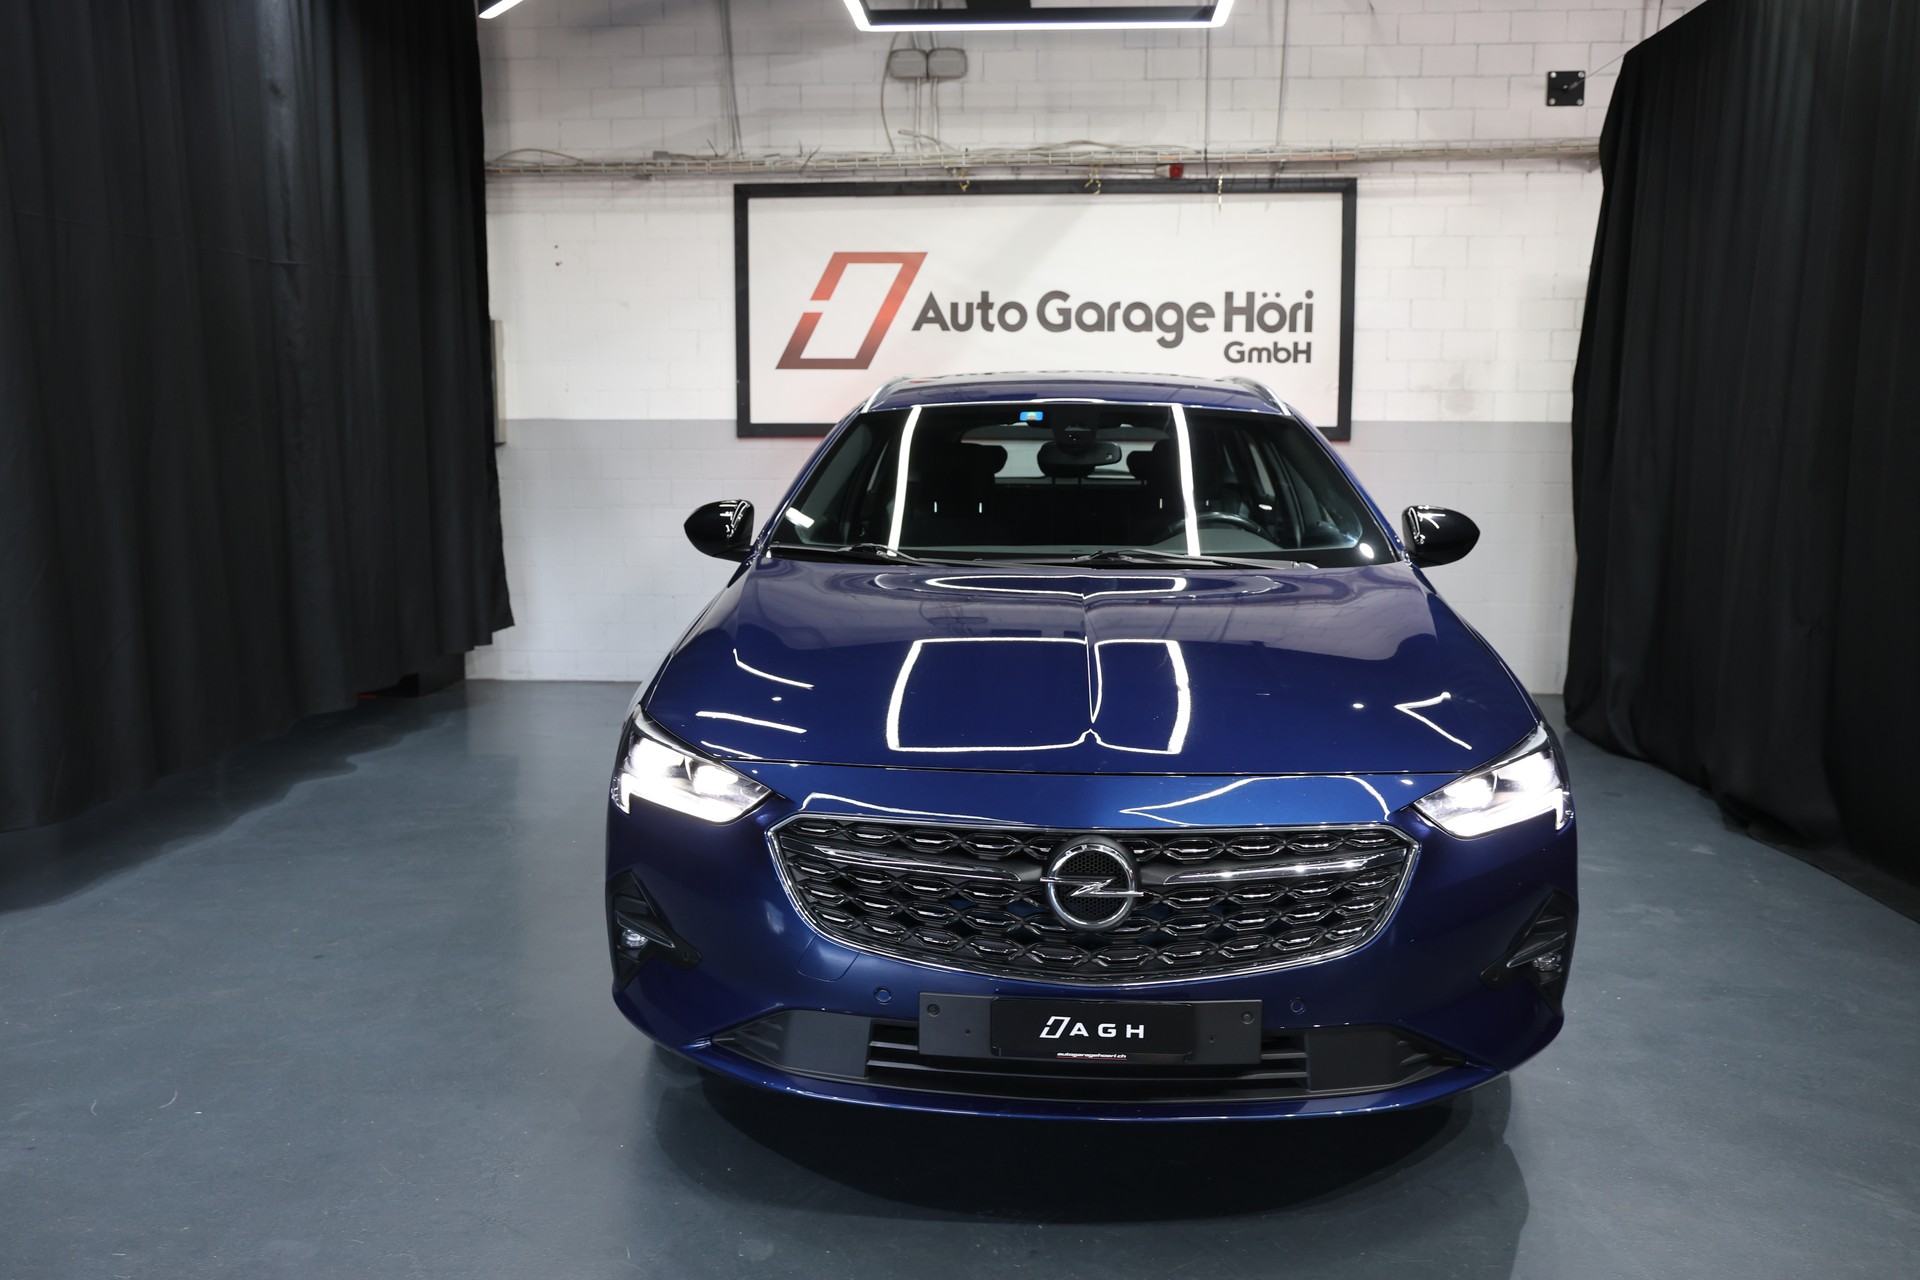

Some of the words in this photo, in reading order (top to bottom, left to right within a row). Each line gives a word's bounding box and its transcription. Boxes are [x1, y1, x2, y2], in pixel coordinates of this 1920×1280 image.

[911, 290, 1028, 333] Auto
[1036, 290, 1216, 349] Garage
[1223, 290, 1314, 334] Höri
[1223, 341, 1312, 365] GmbH
[1068, 1022, 1145, 1039] AGH
